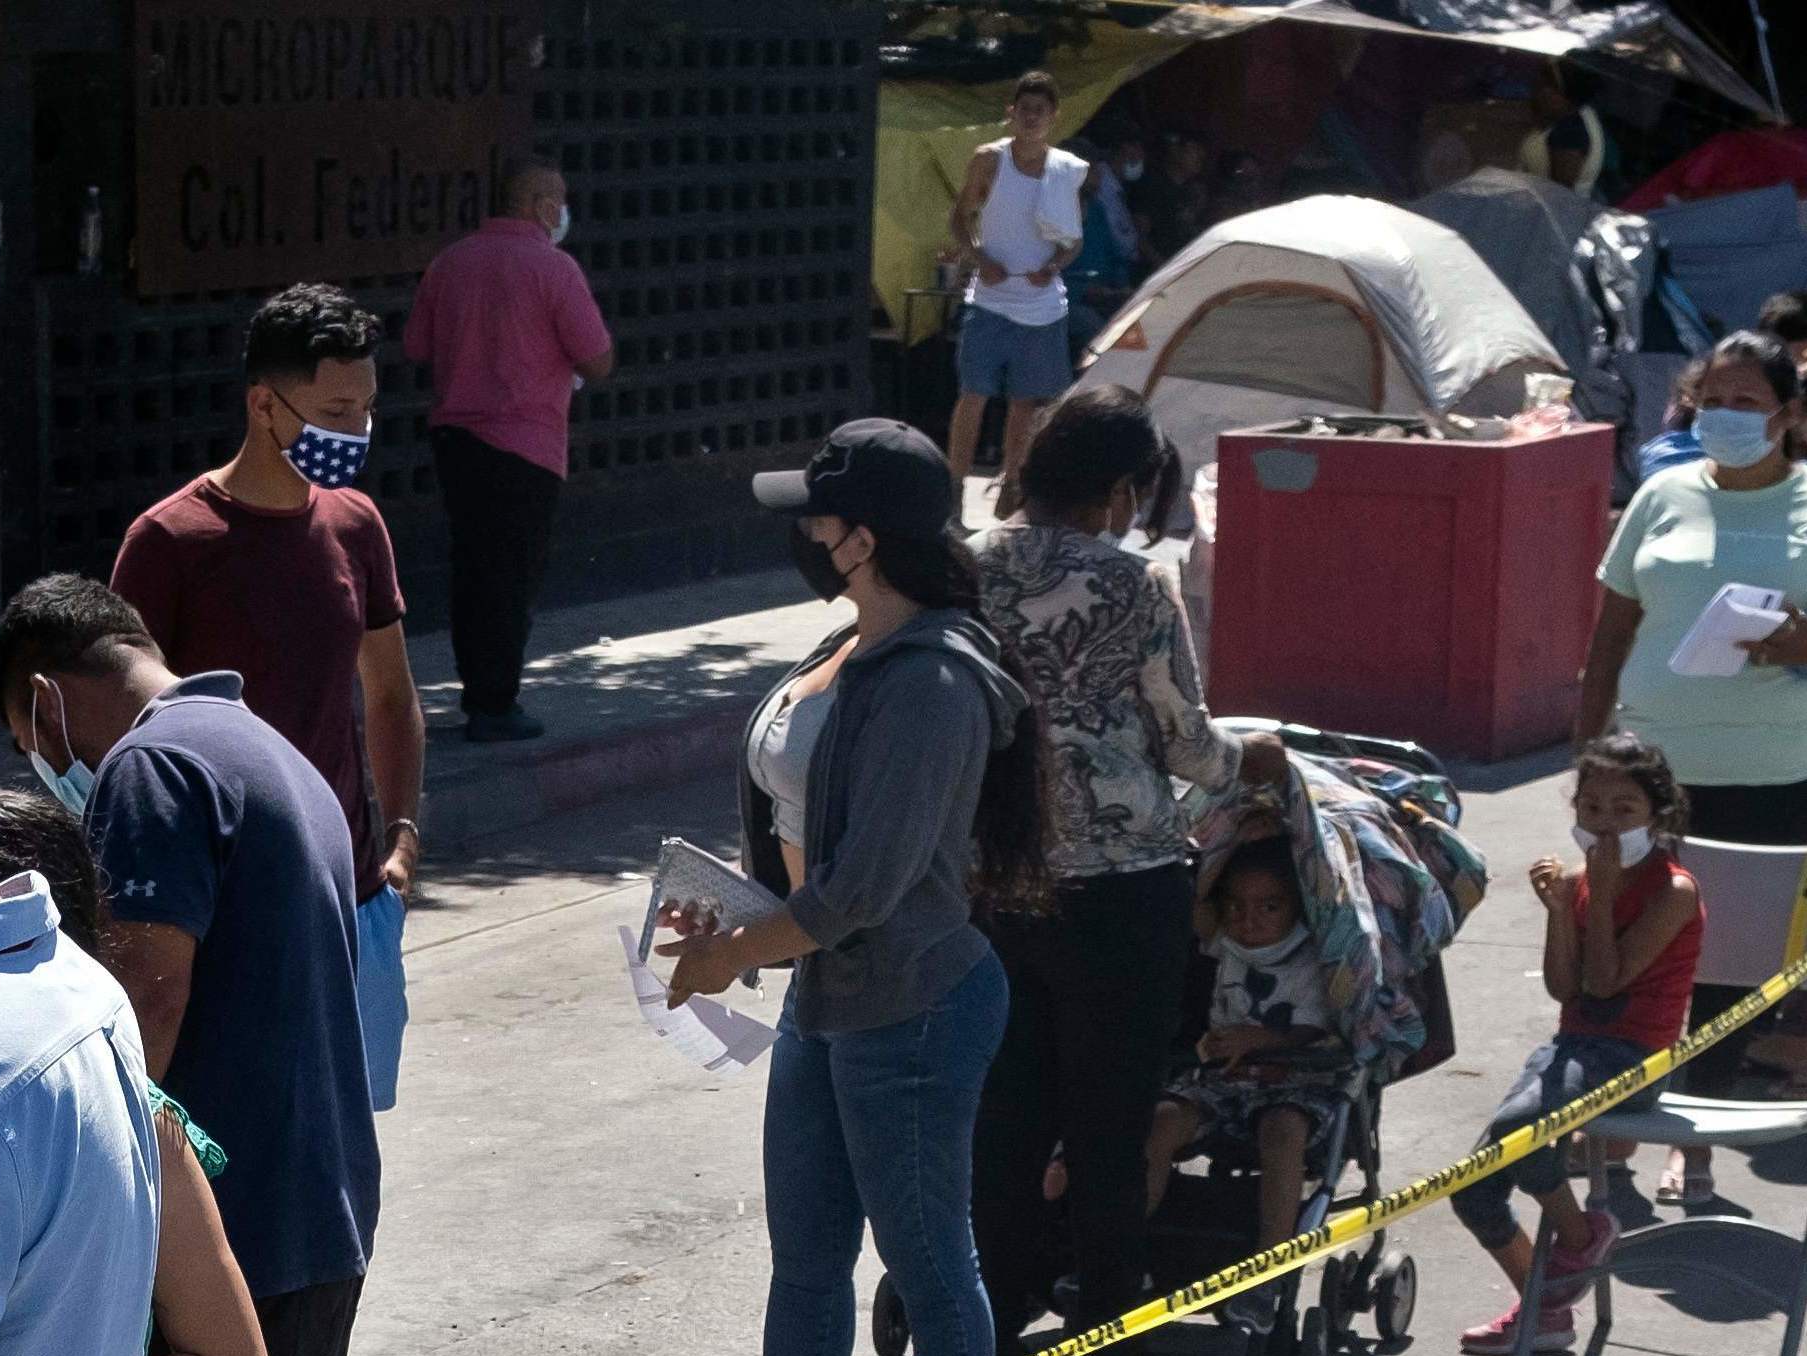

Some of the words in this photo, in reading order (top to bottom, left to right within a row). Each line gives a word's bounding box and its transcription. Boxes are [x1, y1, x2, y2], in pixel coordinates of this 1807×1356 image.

[149, 14, 524, 108] MICROPARQUE
[182, 156, 285, 253] Col.
[314, 142, 500, 243] Federal
